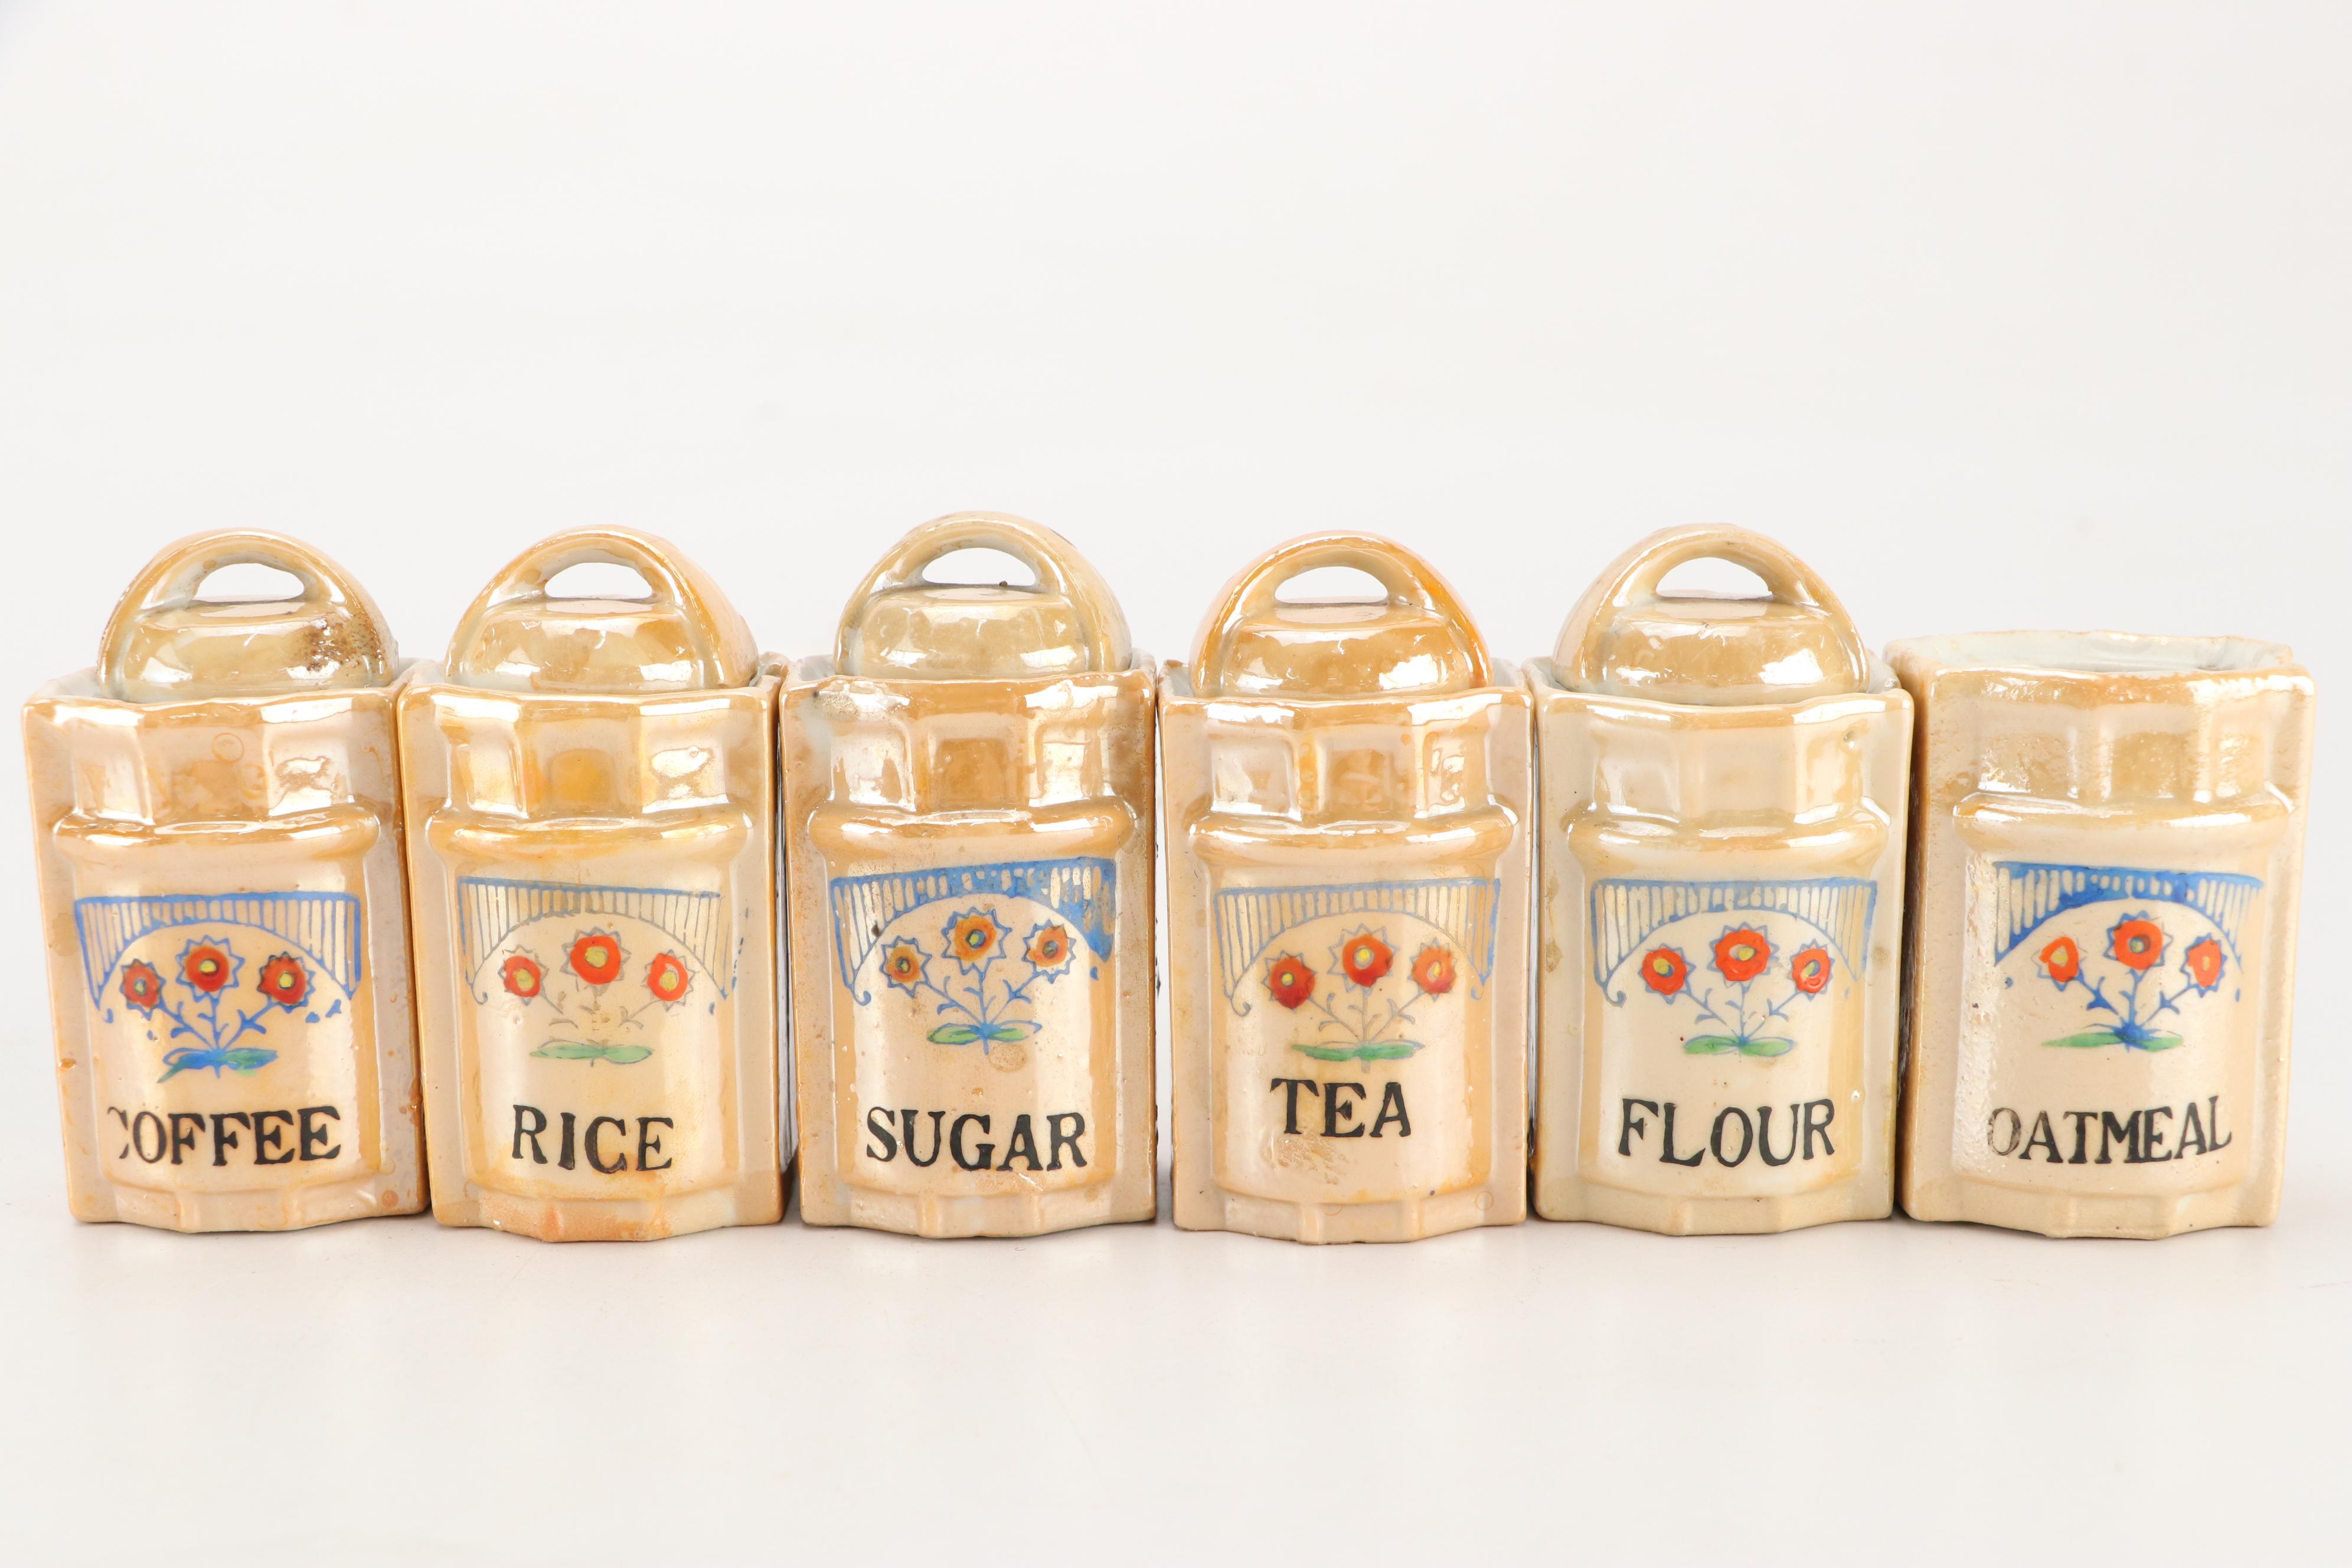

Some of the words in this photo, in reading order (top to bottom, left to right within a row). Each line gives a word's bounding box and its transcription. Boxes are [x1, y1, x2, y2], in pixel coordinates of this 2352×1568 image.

[512, 1104, 674, 1175] RICE
[866, 1106, 1088, 1172] SUGAR
[1270, 1077, 1412, 1139] TEA
[1618, 1097, 1835, 1169] FLOUR
[1987, 1095, 2232, 1165] OATMEAL
